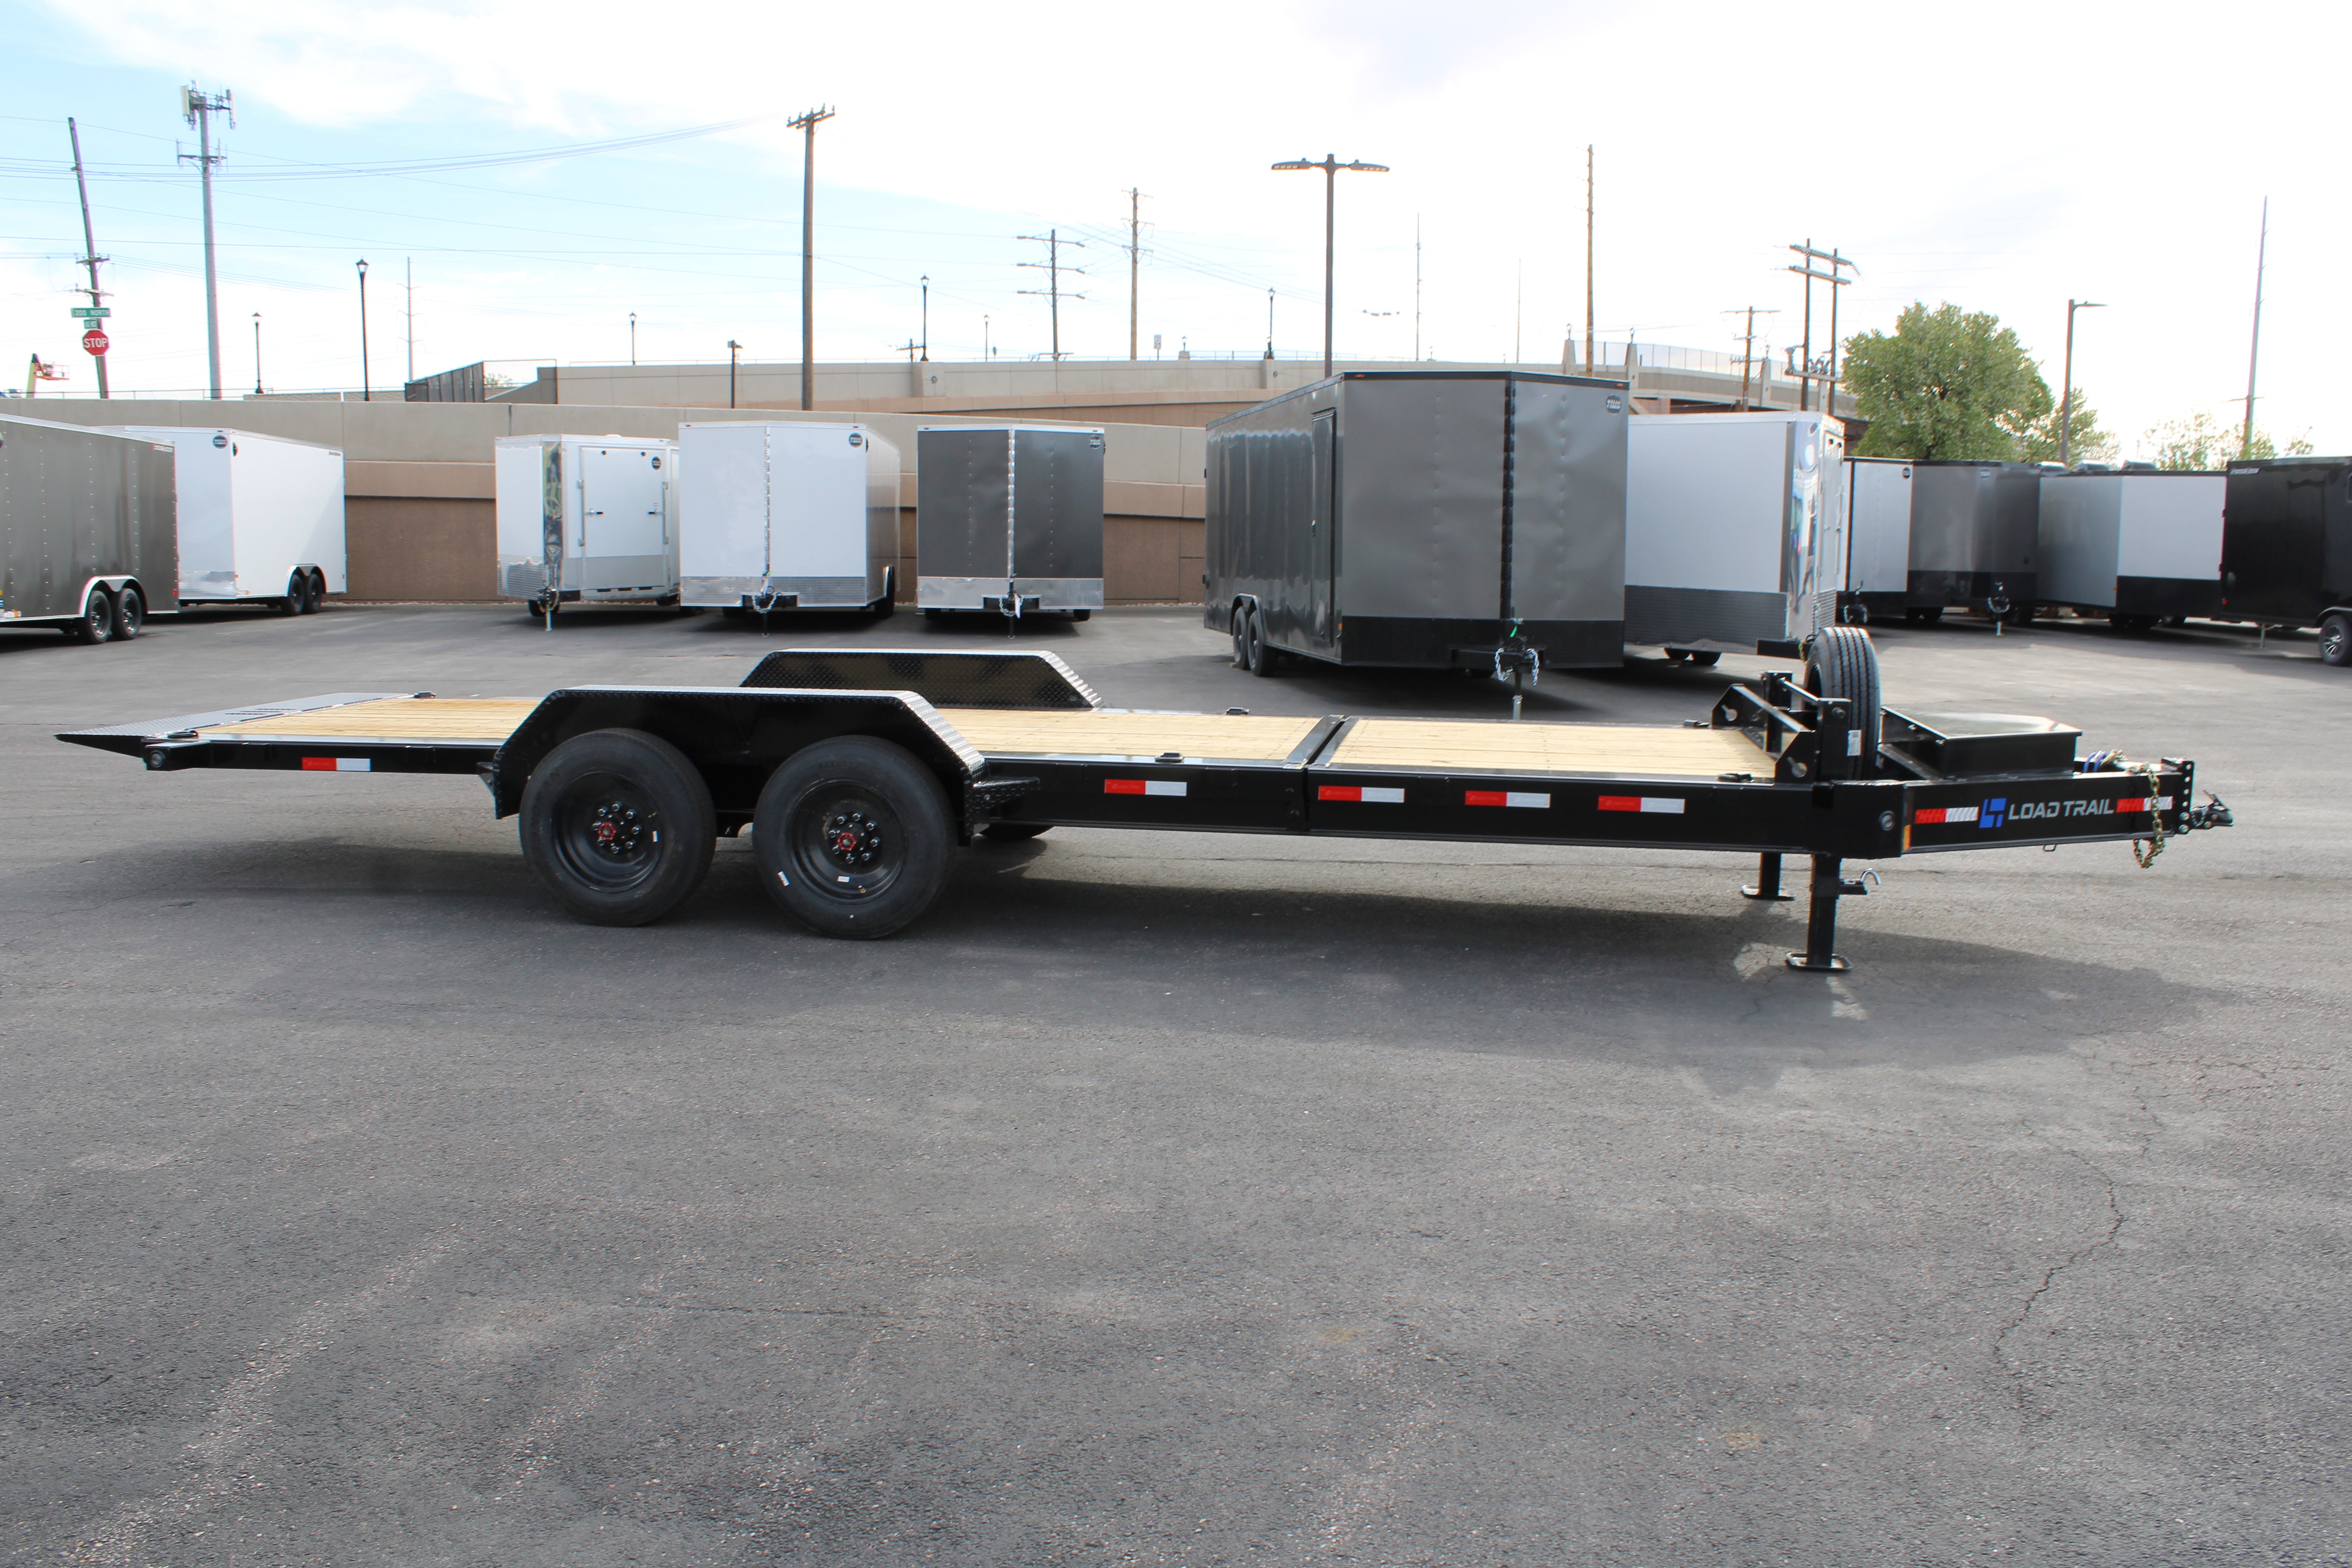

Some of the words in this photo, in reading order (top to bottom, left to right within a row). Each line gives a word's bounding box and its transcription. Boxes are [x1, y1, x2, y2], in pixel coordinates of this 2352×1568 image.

[84, 338, 108, 348] STOP
[2008, 802, 2061, 820] LOAD
[2062, 799, 2114, 817] TRAIL
